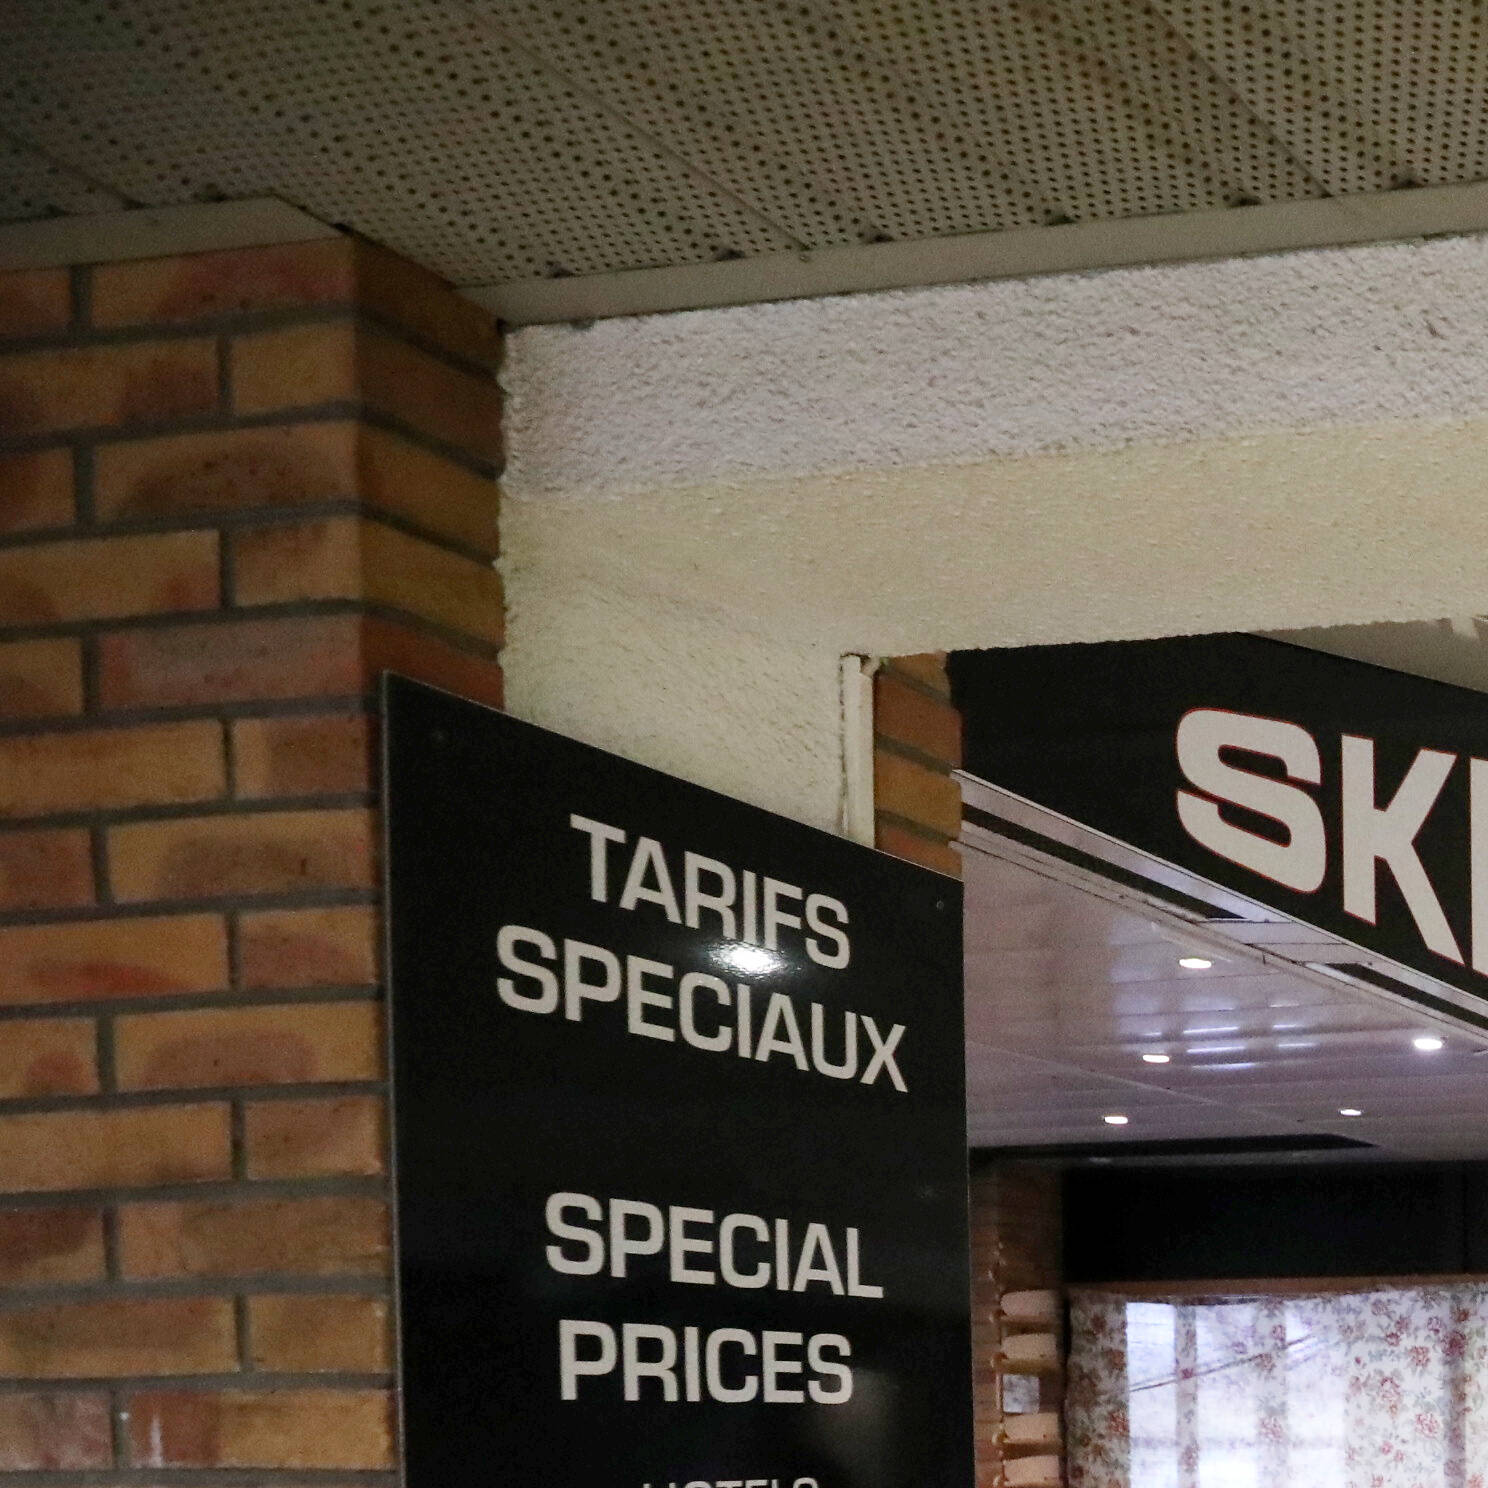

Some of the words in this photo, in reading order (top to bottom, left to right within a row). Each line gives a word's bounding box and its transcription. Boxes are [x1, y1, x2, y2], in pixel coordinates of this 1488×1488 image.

[570, 814, 850, 969] TARIFS
[497, 925, 908, 1092] SPECIAUX
[546, 1192, 883, 1299] SPECIAL
[559, 1319, 853, 1405] PRICES
